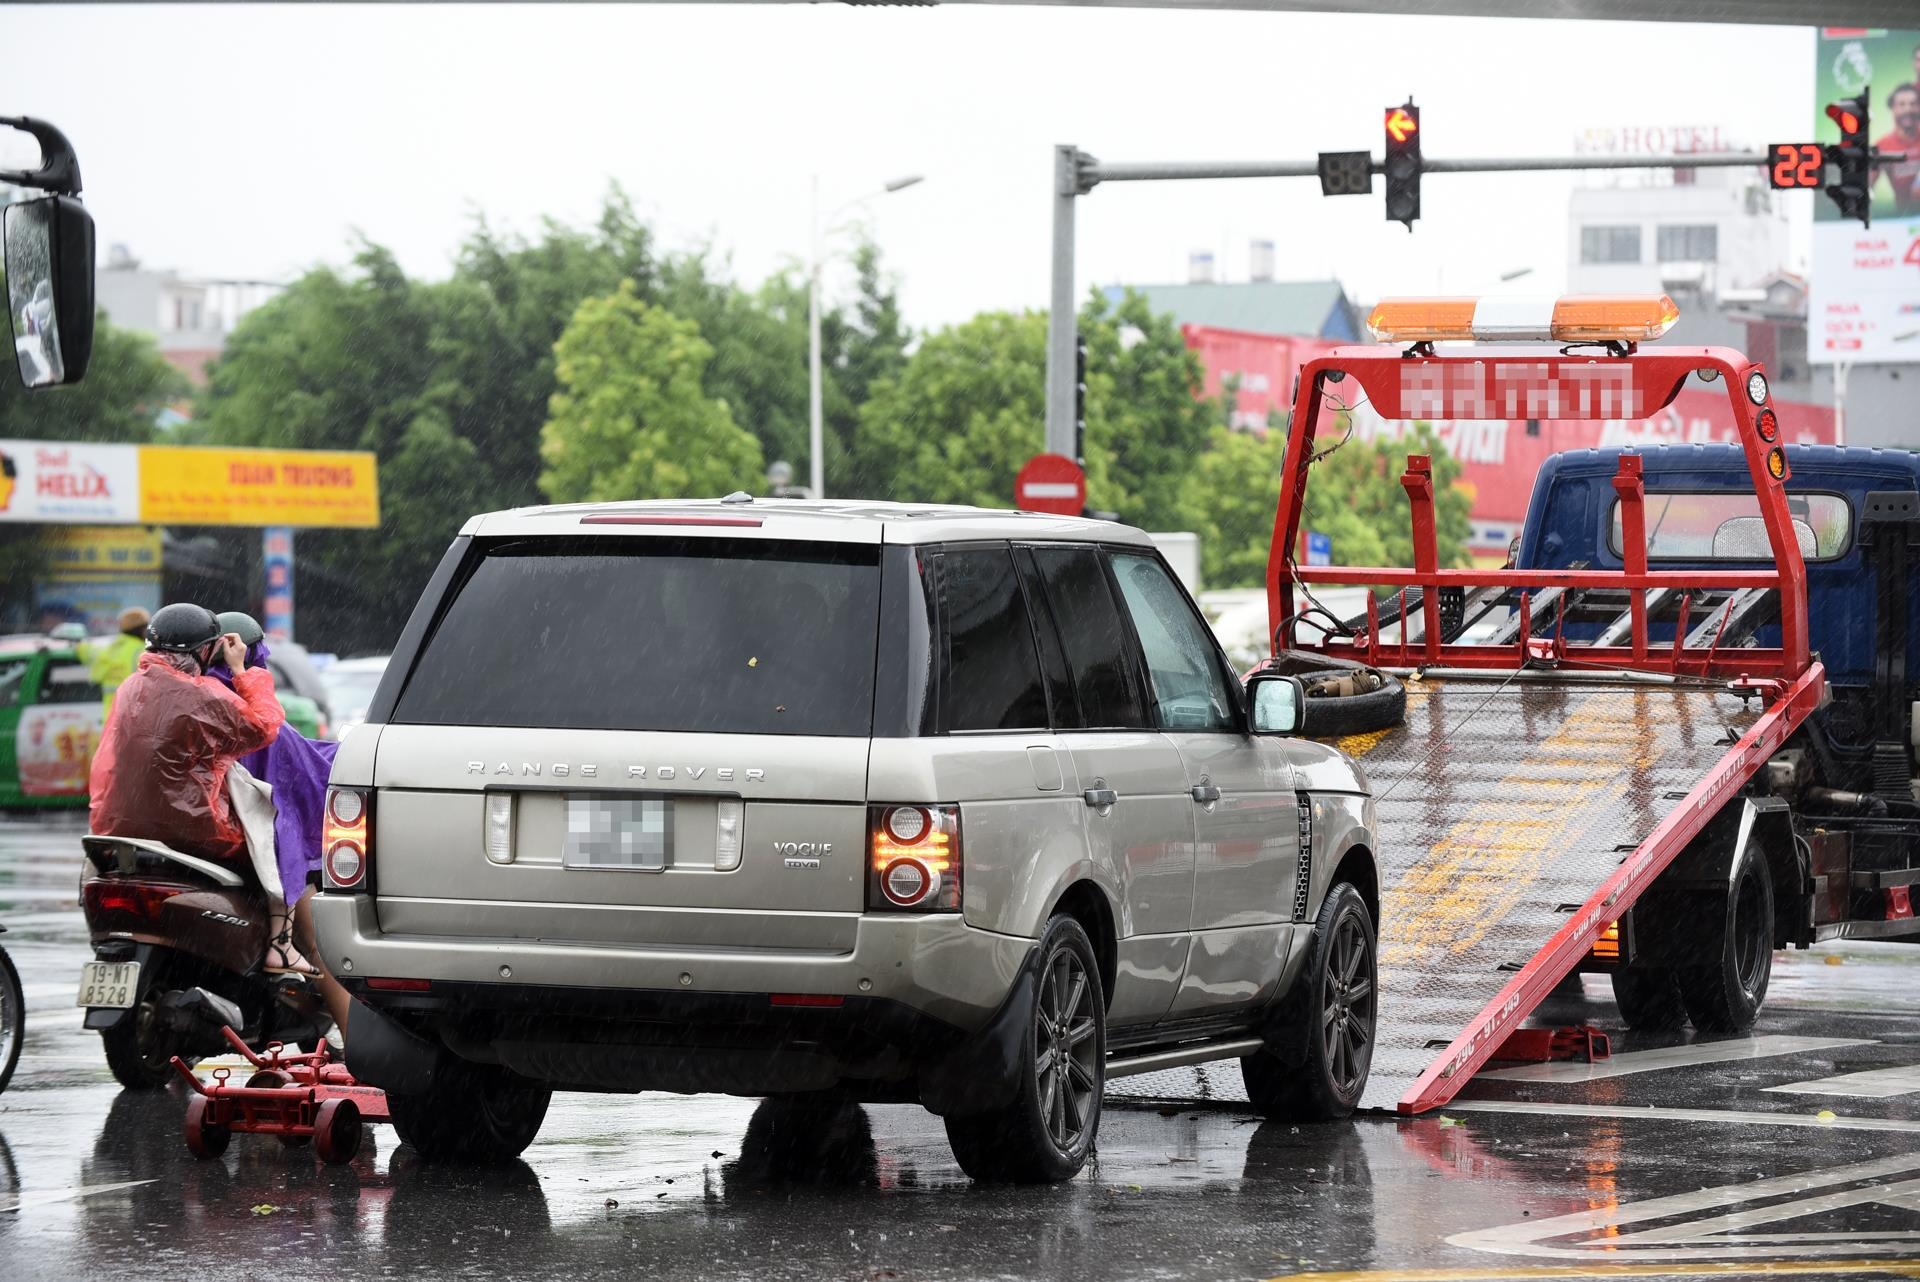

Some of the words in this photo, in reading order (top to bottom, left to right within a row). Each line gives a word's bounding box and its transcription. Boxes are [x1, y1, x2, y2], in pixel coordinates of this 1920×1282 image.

[1622, 126, 1730, 153] HOTEL
[1774, 145, 1821, 186] 22
[36, 473, 112, 498] HELIX
[466, 760, 598, 778] RANGE
[627, 764, 767, 783] ROVER
[773, 842, 833, 857] VOGUE
[786, 860, 819, 868] TDV8
[201, 910, 250, 928] LEAD
[91, 965, 131, 985] 19-N1
